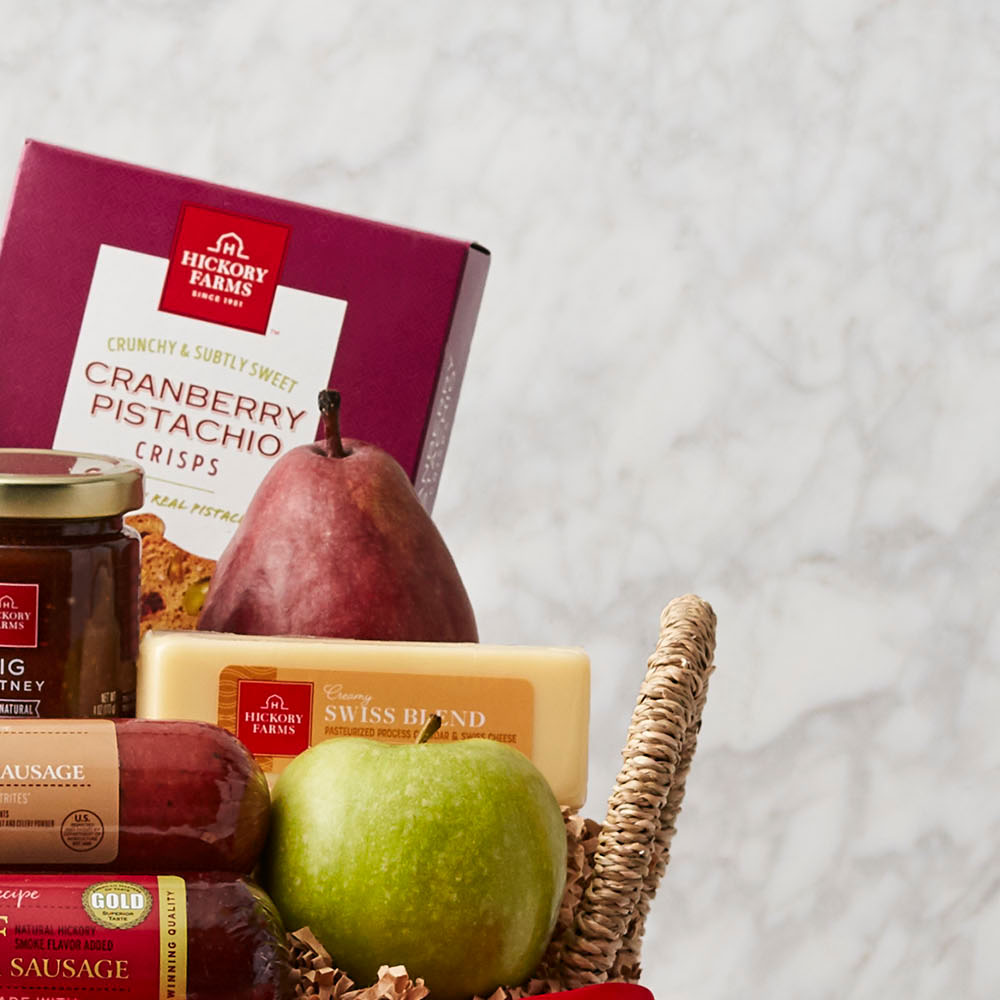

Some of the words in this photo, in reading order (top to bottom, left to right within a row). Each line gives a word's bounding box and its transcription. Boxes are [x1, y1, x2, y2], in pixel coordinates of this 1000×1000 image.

[181, 250, 269, 284] HICKORY
[189, 270, 253, 297] FARMS
[192, 290, 220, 303] SINCE
[107, 336, 177, 355] CRUNCHY
[180, 343, 189, 358] &
[194, 345, 249, 372] SUBTLY
[249, 361, 299, 394] SWEET
[85, 361, 306, 430] CRANBERRY
[91, 393, 281, 457] PISTACHIO
[135, 441, 219, 476] CRISPS
[150, 494, 187, 510] REAL
[323, 683, 372, 705] Creamy
[0, 703, 33, 715] NATURAL
[245, 711, 303, 724] HICKORY
[324, 704, 395, 724] SWISS
[253, 723, 296, 735] FARMS
[324, 726, 376, 738] PASTEURIZED
[377, 728, 411, 739] PROCESS
[90, 892, 145, 910] GOLD
[167, 891, 177, 936] QUALITY
[15, 925, 54, 936] NATURAL
[57, 925, 97, 936] HICKORY
[15, 939, 45, 950] SMOKE
[47, 939, 81, 951] FLAVOR
[83, 940, 114, 951] ADDED
[10, 958, 129, 979] SAUSAGE
